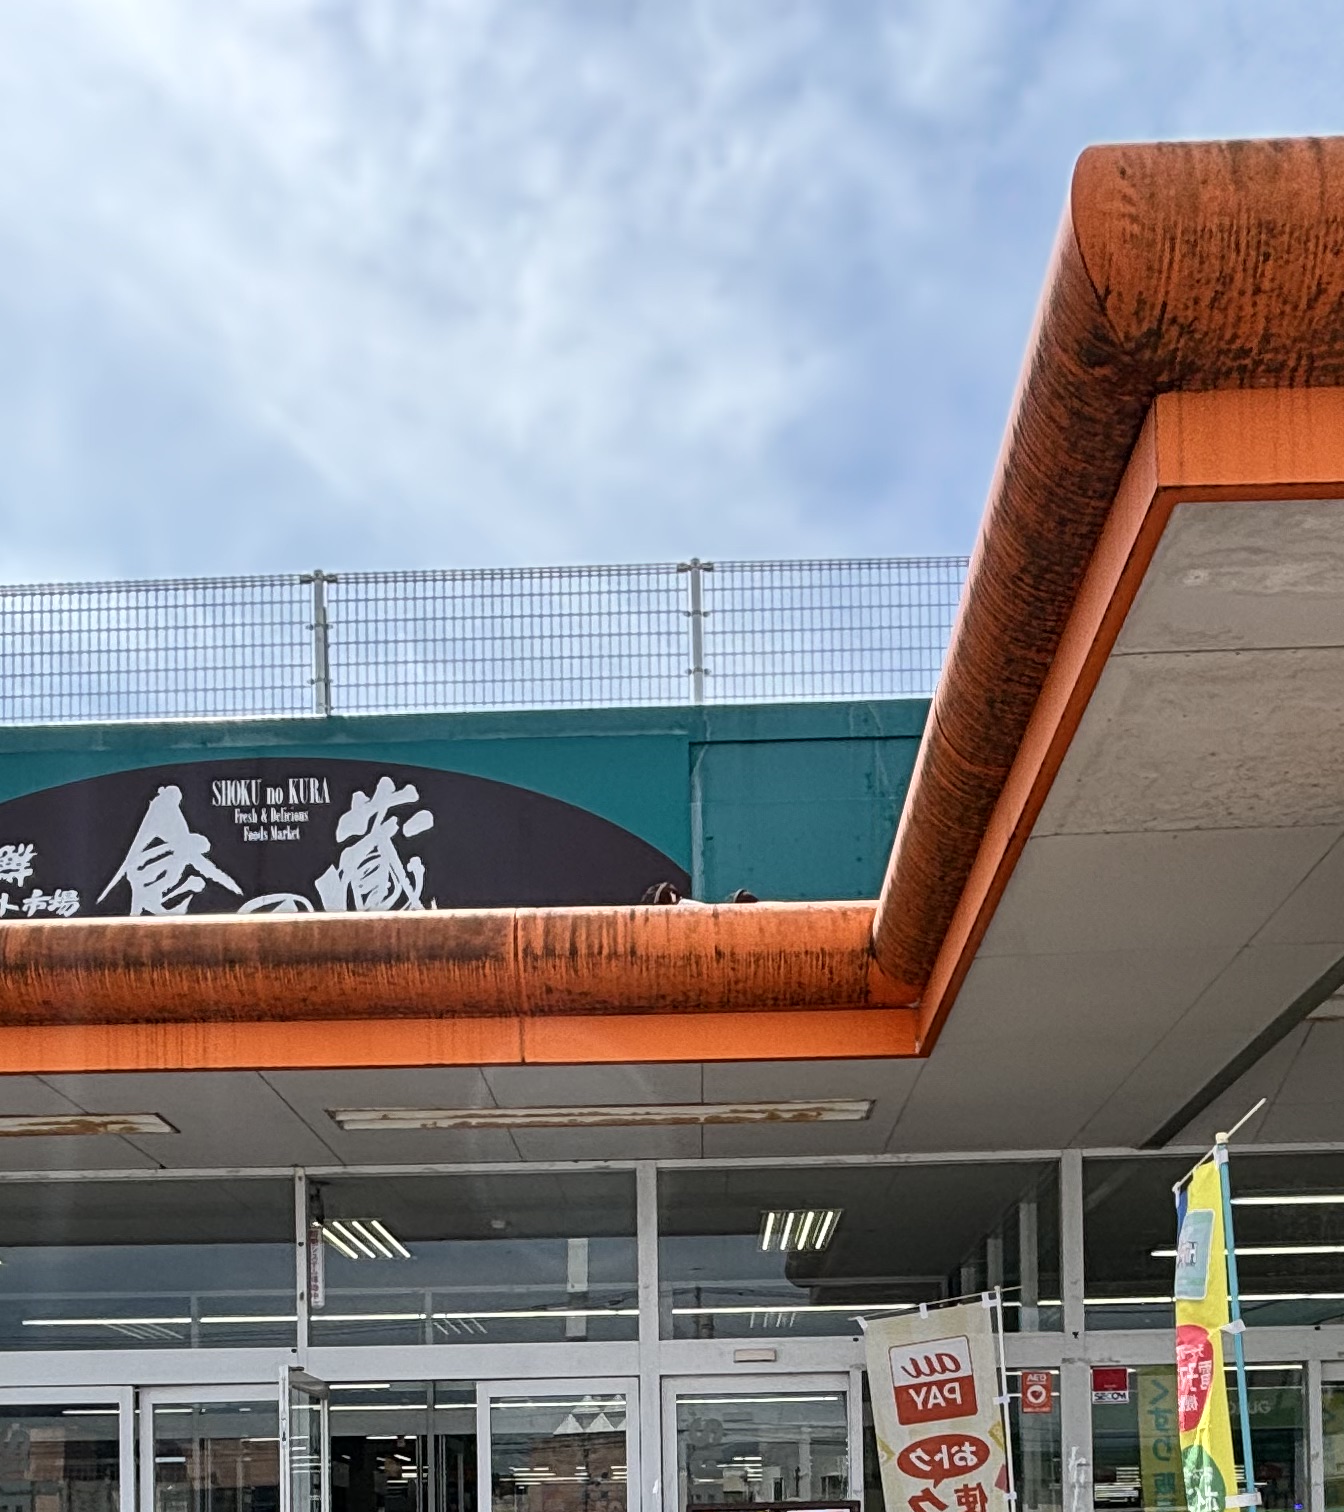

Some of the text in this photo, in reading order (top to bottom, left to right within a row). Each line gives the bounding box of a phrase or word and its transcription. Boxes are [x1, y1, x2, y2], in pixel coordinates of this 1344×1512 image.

[211, 776, 331, 807] SHOKU no KURA
[234, 806, 309, 824] Fresh & Delicious
[243, 824, 301, 842] Foods Market
[1026, 1373, 1047, 1383] AED
[1094, 1391, 1127, 1401] SECOM
